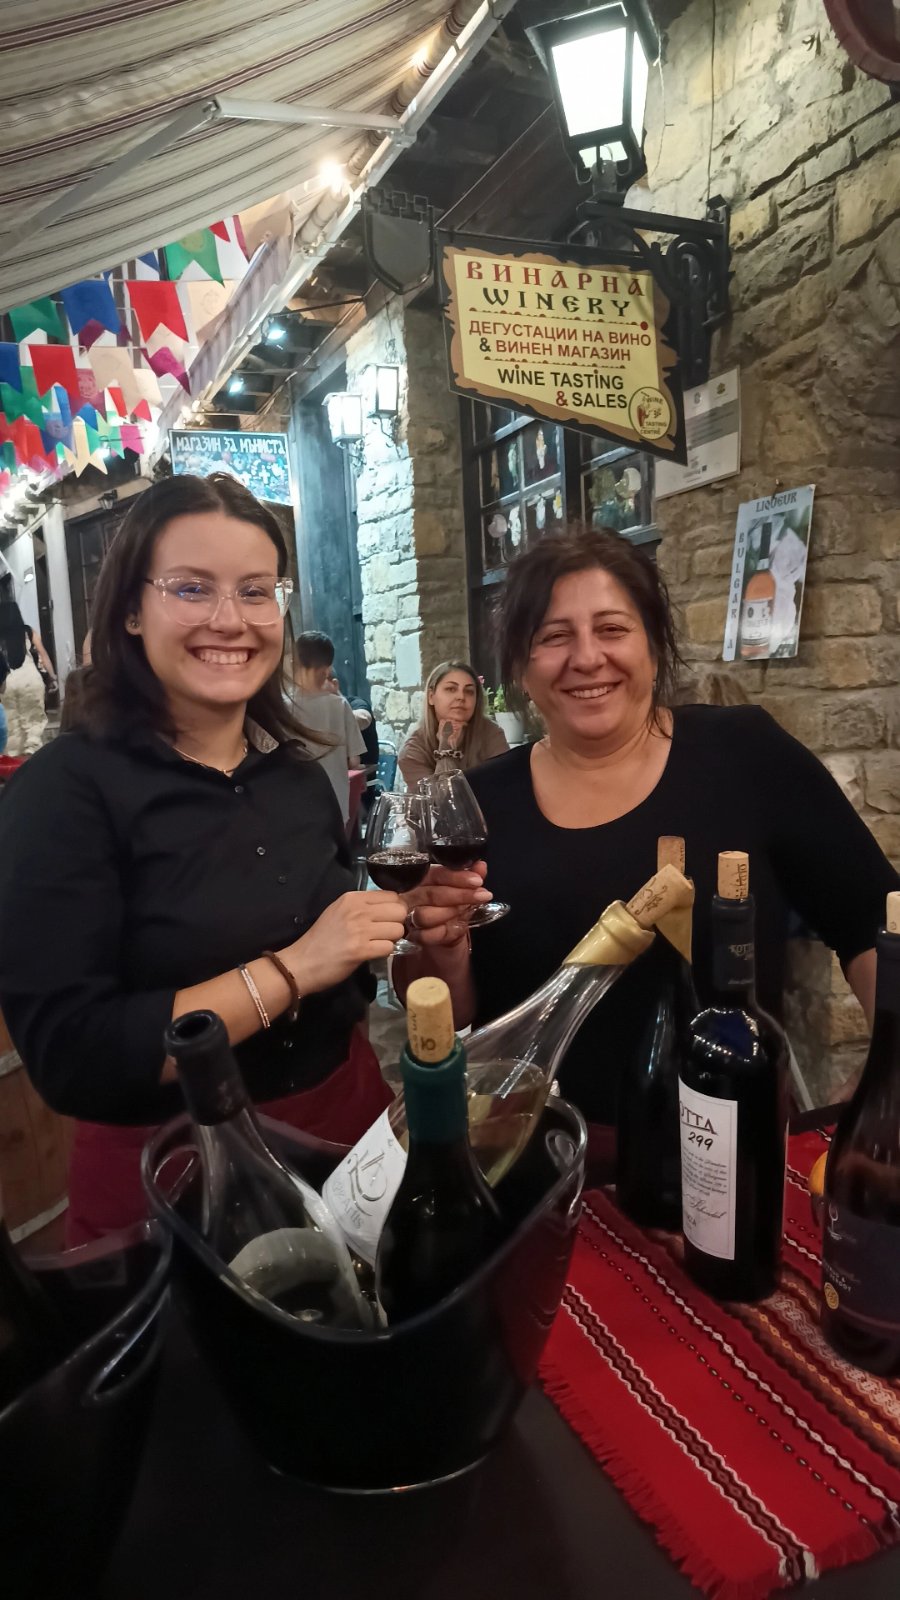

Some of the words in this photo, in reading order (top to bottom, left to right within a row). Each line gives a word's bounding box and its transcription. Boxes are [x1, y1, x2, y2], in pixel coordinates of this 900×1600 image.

[467, 261, 645, 297] ВИНАРНА
[482, 287, 631, 317] WINERY
[469, 320, 578, 342] ДЕГУСТАЦИИ
[582, 331, 605, 344] НА
[609, 331, 651, 347] ВИНО
[479, 337, 492, 352] &
[496, 340, 553, 356] ВИНЕН
[558, 345, 631, 361] МАГАЗИН
[556, 390, 569, 407] &
[572, 392, 628, 409] SALES
[176, 436, 220, 453] МАГАЗИН
[224, 437, 238, 453] ЗА
[240, 438, 286, 455] МЪНИСТА
[756, 492, 797, 513] LIQUEUR
[688, 1131, 714, 1151] 299
